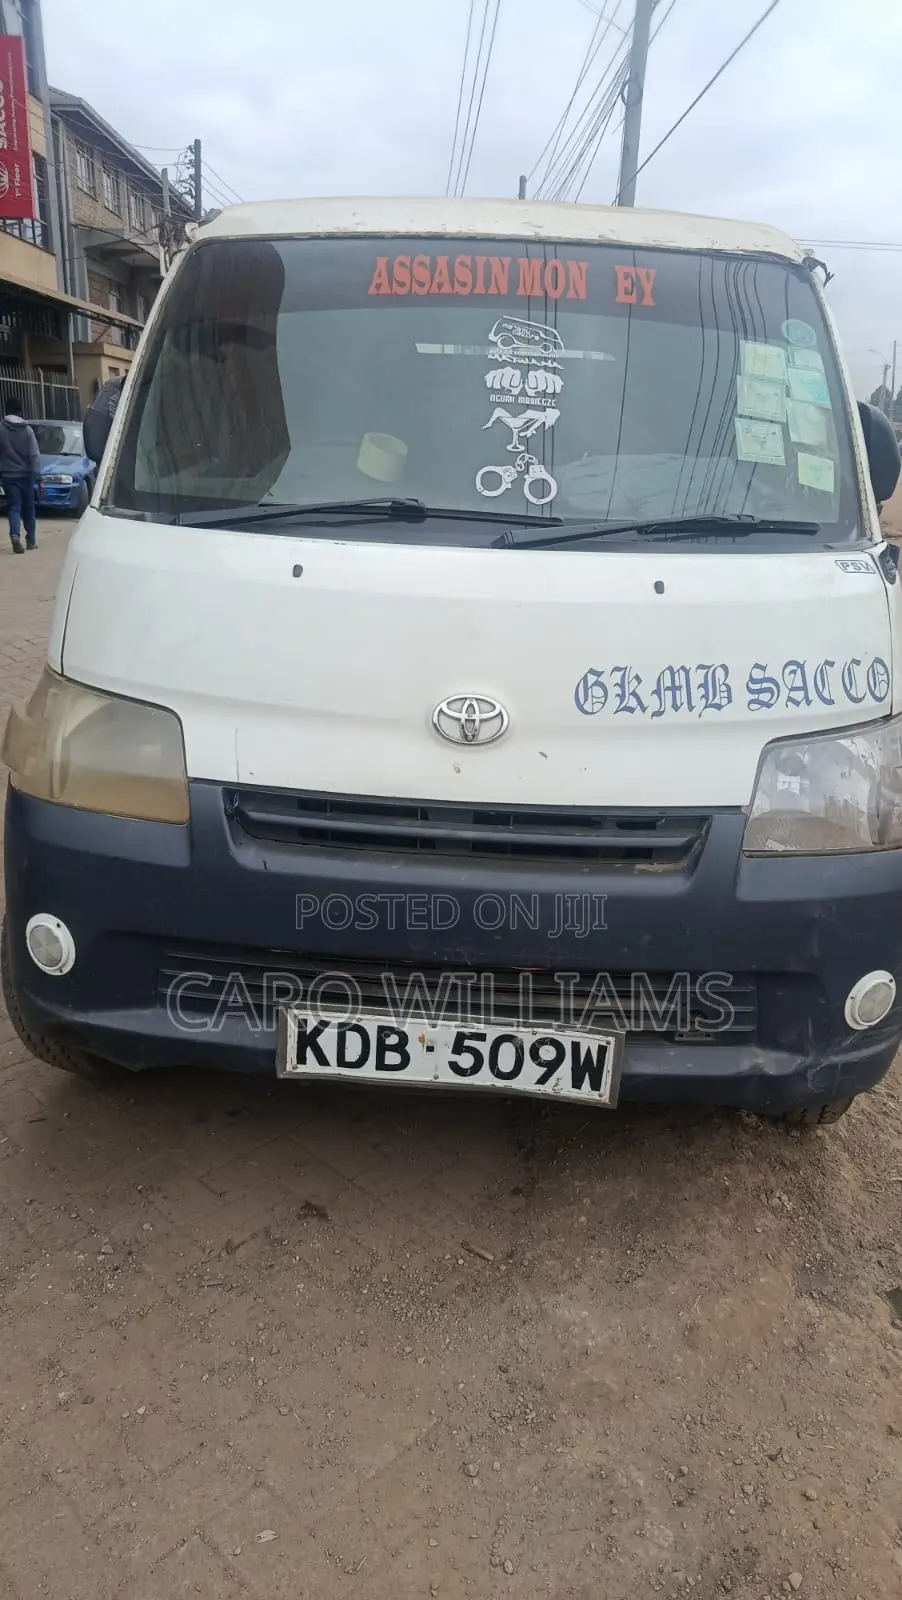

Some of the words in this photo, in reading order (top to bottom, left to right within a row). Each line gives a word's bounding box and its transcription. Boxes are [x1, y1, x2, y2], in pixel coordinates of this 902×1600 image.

[367, 254, 511, 296] ASSASIN
[516, 257, 590, 300] MON
[612, 264, 657, 306] EY
[839, 562, 870, 572] PSV
[574, 663, 732, 720] GKMB
[746, 656, 890, 712] SACCO
[296, 1018, 411, 1072] KDB
[447, 1031, 608, 1092] 509W
